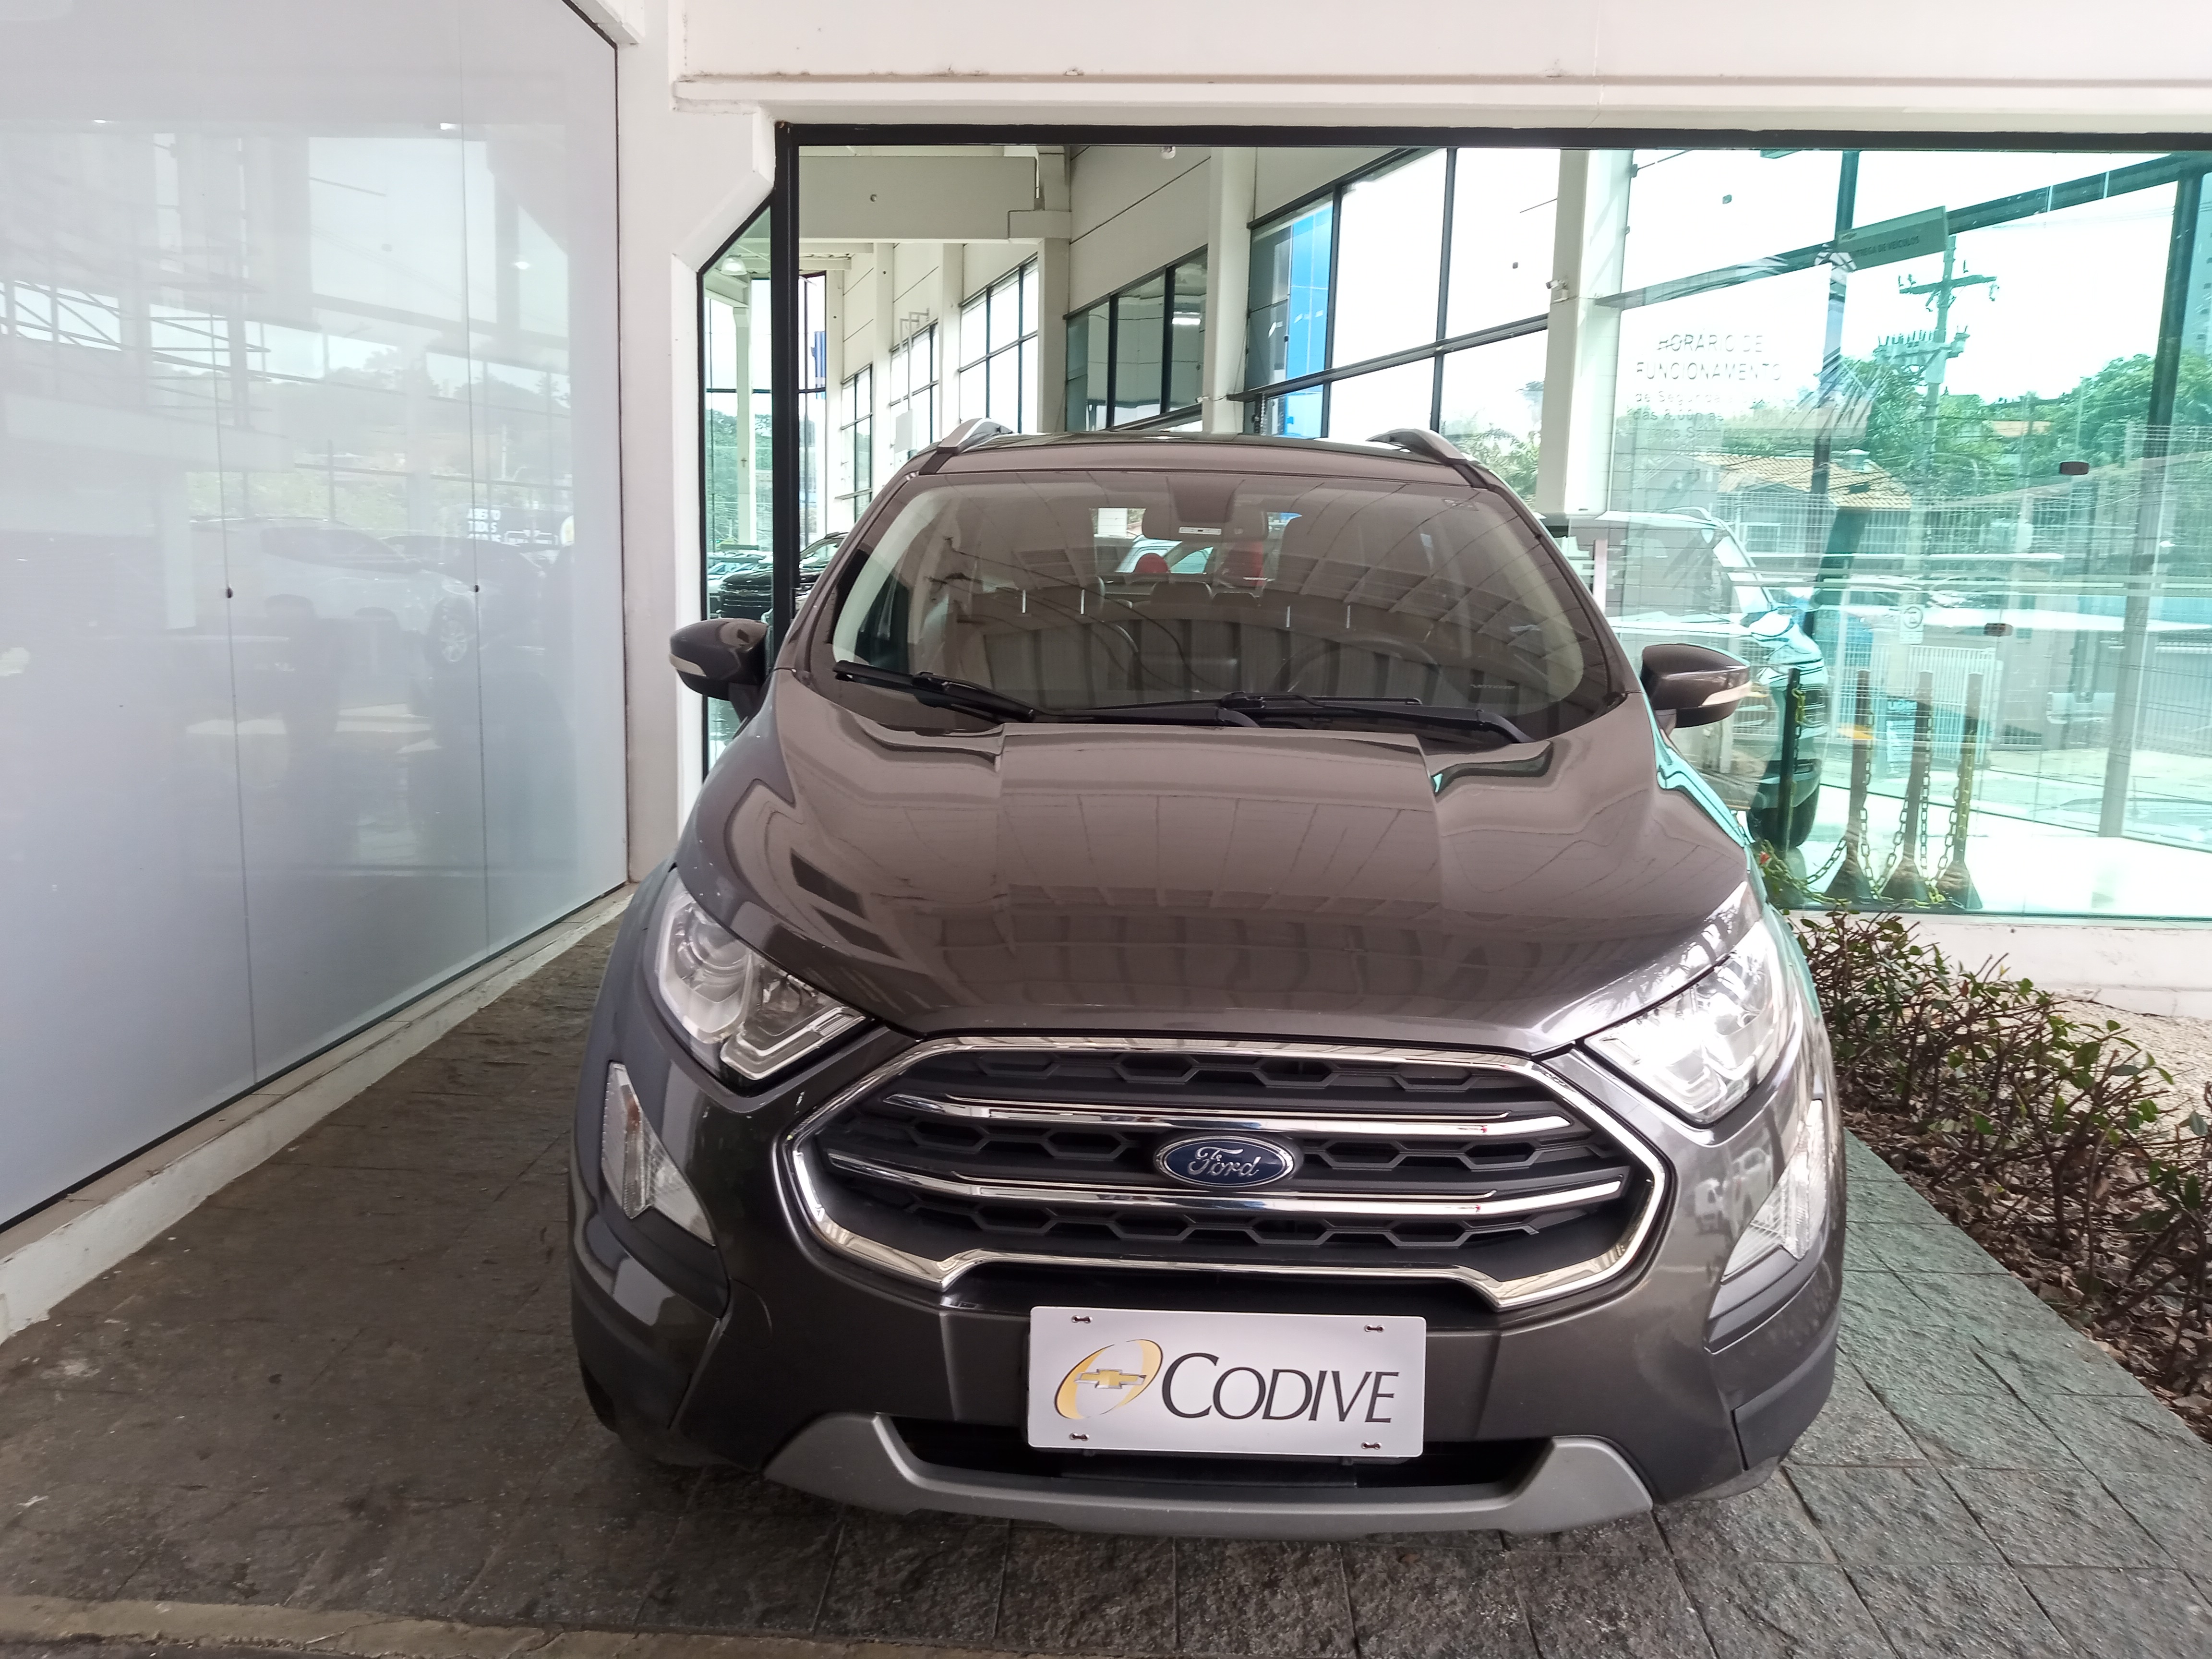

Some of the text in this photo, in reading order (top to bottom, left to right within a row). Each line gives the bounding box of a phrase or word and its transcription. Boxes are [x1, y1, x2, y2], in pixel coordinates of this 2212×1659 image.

[1636, 361, 1782, 381] FUNCIONAMENTO
[1187, 1146, 1261, 1176] Ford
[1161, 1352, 1400, 1424] CODIVE
